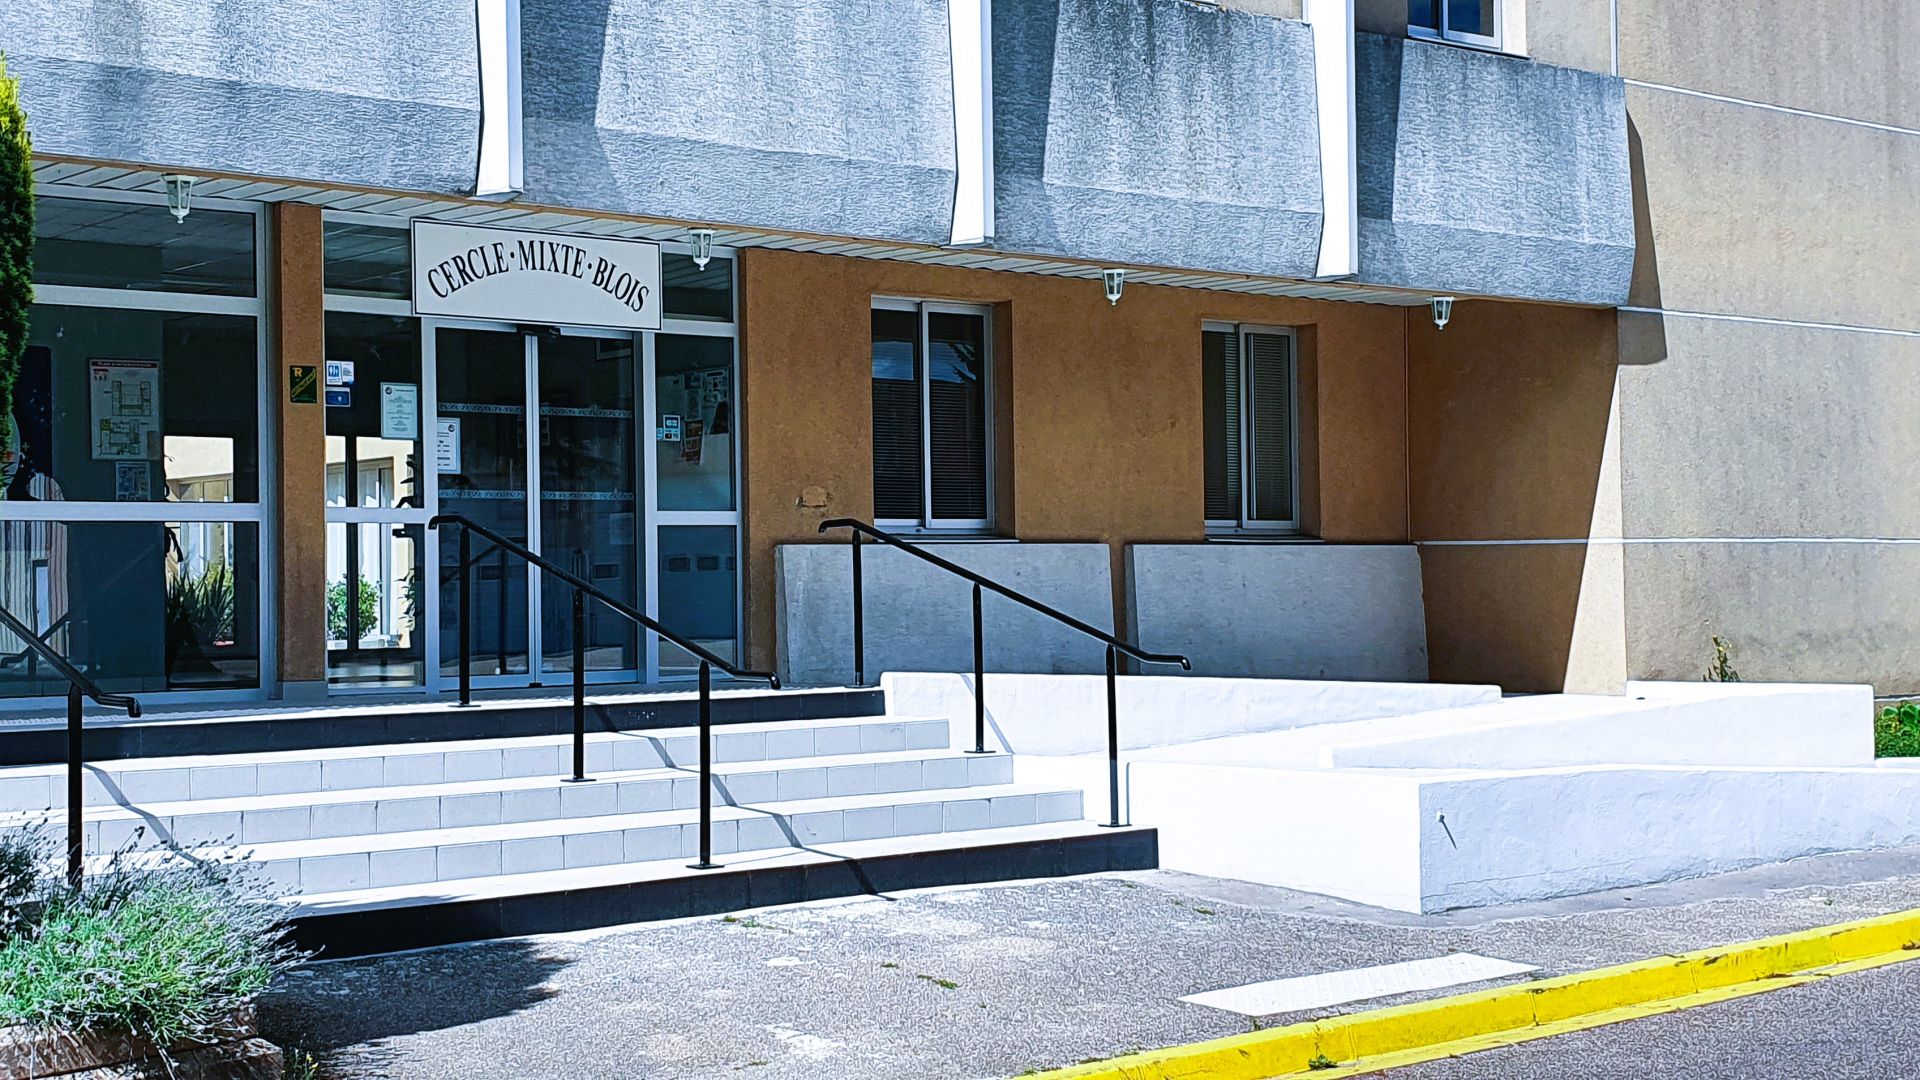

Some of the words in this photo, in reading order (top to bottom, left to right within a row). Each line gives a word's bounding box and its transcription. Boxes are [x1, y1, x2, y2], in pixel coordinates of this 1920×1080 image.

[427, 243, 509, 299] CERCLE
[517, 240, 587, 279] MIXTE
[592, 257, 650, 313] BLOIS
